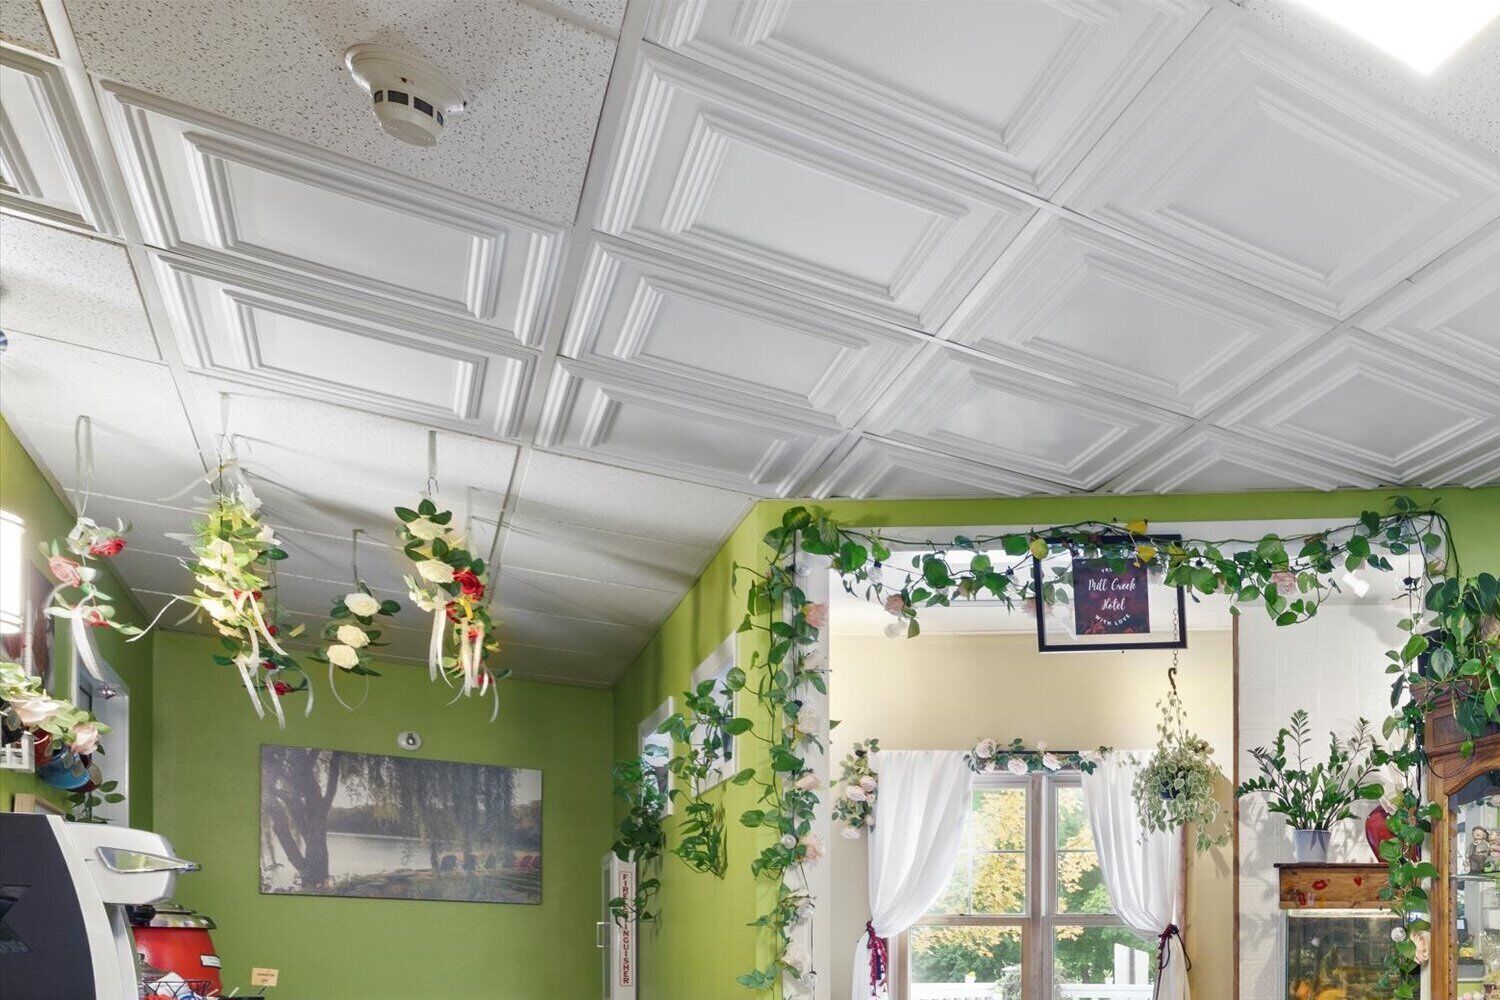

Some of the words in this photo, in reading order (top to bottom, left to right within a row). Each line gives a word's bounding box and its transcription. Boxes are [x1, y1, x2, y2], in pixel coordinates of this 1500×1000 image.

[1088, 578, 1107, 591] Mill
[1111, 577, 1136, 591] Creek
[1101, 597, 1126, 610] Hotel
[1095, 614, 1112, 625] WITH
[1114, 613, 1131, 625] LOVE
[622, 874, 630, 899] FIRE
